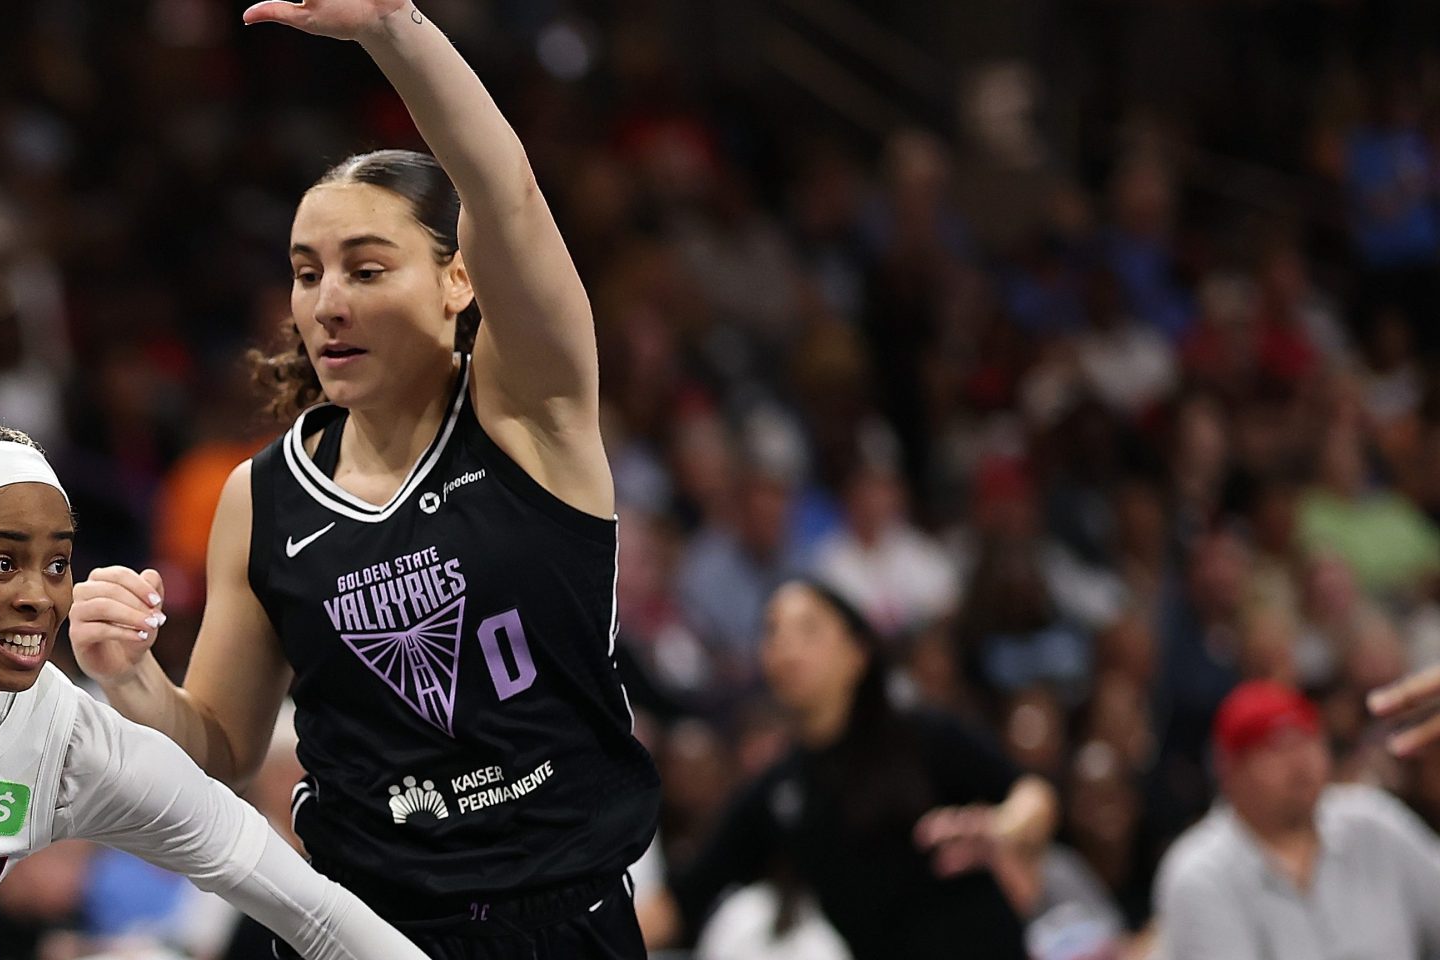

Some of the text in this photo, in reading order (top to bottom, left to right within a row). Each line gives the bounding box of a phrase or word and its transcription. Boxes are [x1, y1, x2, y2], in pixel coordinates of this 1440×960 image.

[443, 468, 486, 503] freedom
[323, 557, 466, 631] VALKYRIES
[337, 546, 440, 593] GOLDEN STATE
[476, 608, 537, 701] 0
[451, 766, 504, 794] KAISER
[458, 760, 554, 814] PERMANENTE
